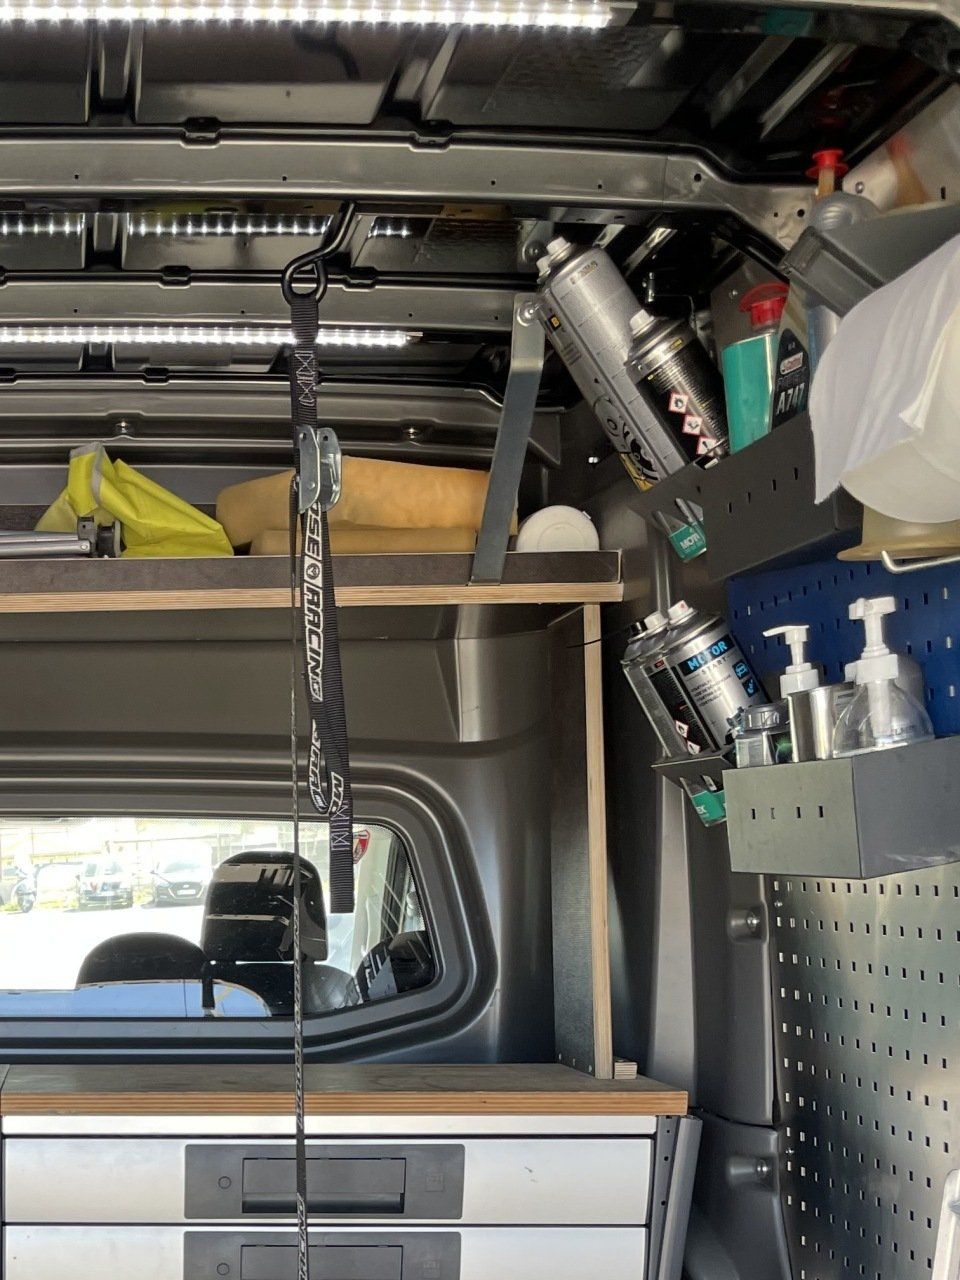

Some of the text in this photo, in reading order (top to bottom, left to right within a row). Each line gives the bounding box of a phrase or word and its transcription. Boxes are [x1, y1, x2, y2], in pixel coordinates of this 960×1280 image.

[304, 582, 323, 701] RACING
[687, 641, 728, 671] MOTOR
[701, 656, 728, 675] START
